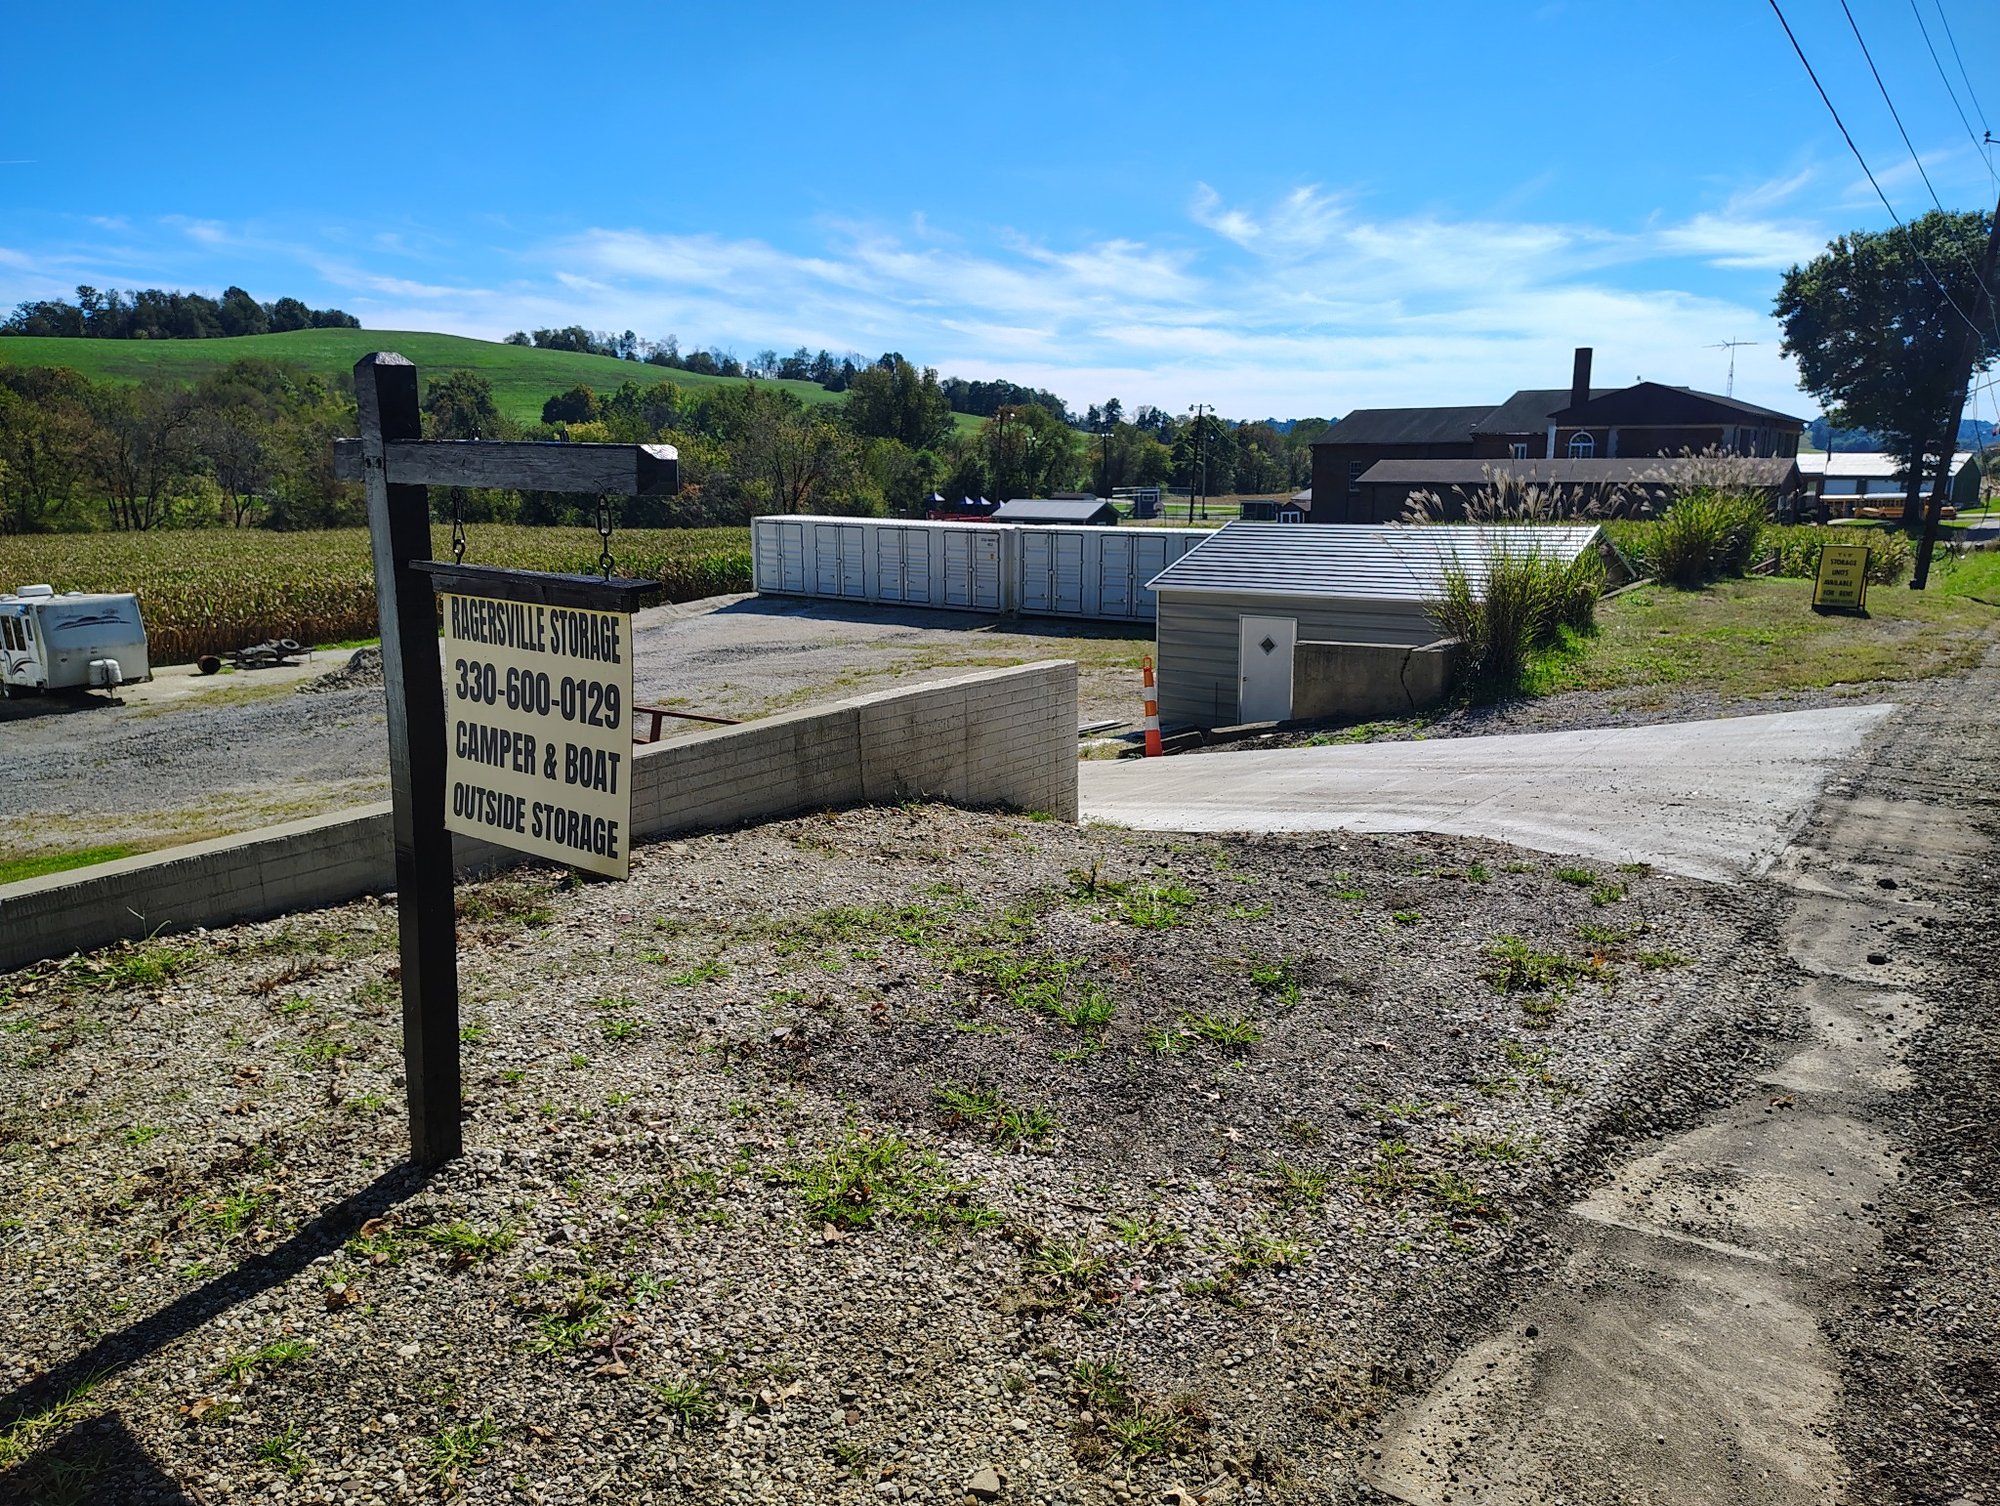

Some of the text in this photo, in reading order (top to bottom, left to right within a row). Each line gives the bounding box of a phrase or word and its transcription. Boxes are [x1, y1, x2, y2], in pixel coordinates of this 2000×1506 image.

[451, 596, 620, 664] RAGERSVILLE STORAGE
[455, 658, 620, 729] 330-600-0129
[456, 720, 620, 795] CAMPER & BOAT
[453, 782, 619, 860] OUTSIDE STORAGE
